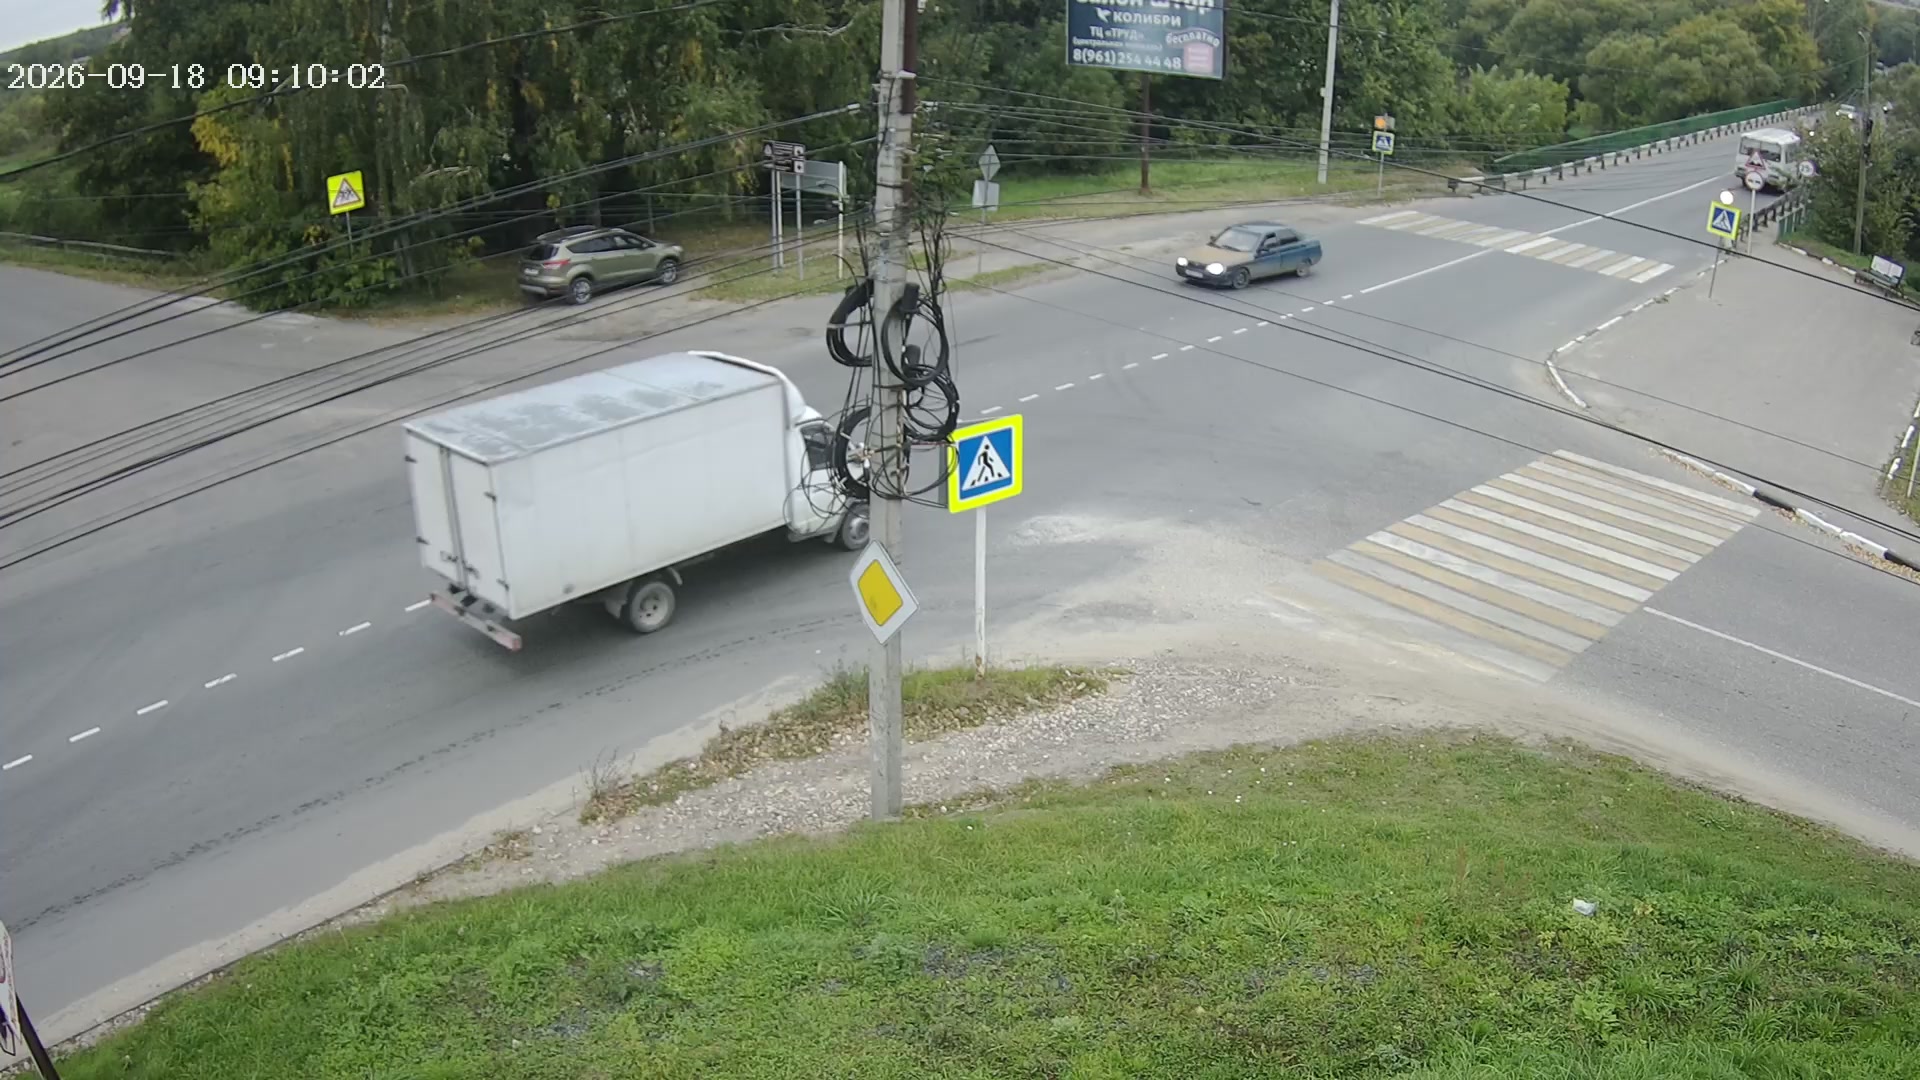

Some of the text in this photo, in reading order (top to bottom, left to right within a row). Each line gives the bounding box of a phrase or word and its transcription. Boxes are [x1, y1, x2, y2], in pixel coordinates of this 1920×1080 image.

[1113, 11, 1181, 27] КОЛИБРИ
[1089, 26, 1104, 39] ТЦ
[1165, 31, 1220, 47] бесплатно
[1073, 48, 1116, 64] 8(961)
[1117, 51, 1141, 64] 254
[1144, 55, 1161, 67] 44
[1163, 56, 1182, 69] 48
